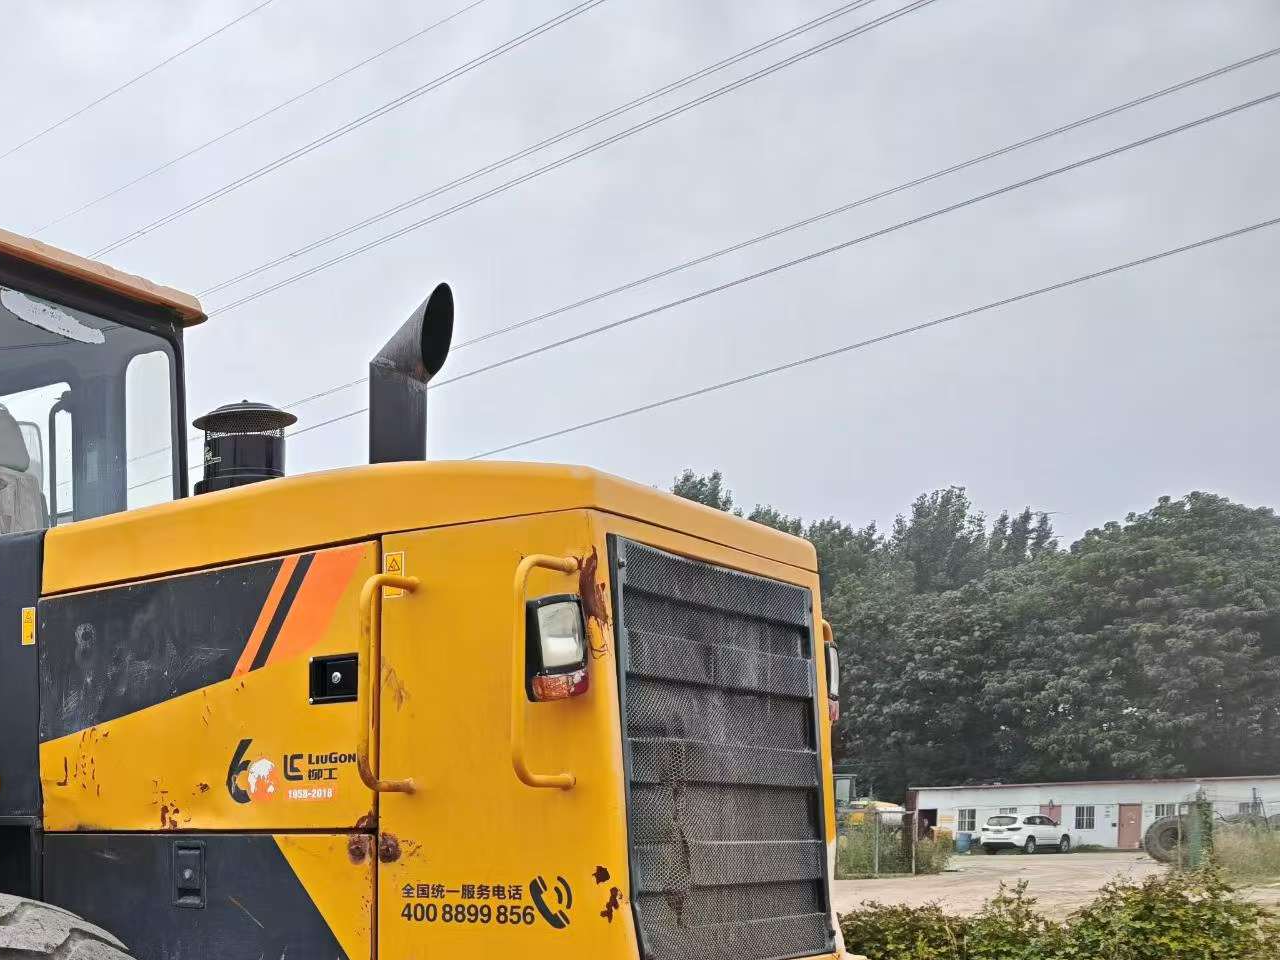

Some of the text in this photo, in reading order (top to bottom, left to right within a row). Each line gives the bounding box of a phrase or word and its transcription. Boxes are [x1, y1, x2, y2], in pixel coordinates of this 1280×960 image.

[308, 752, 356, 765] LIUGON
[308, 767, 338, 780] 柳工
[400, 883, 523, 901] 全国统一服务电话
[401, 903, 536, 926] 400 8899 856
